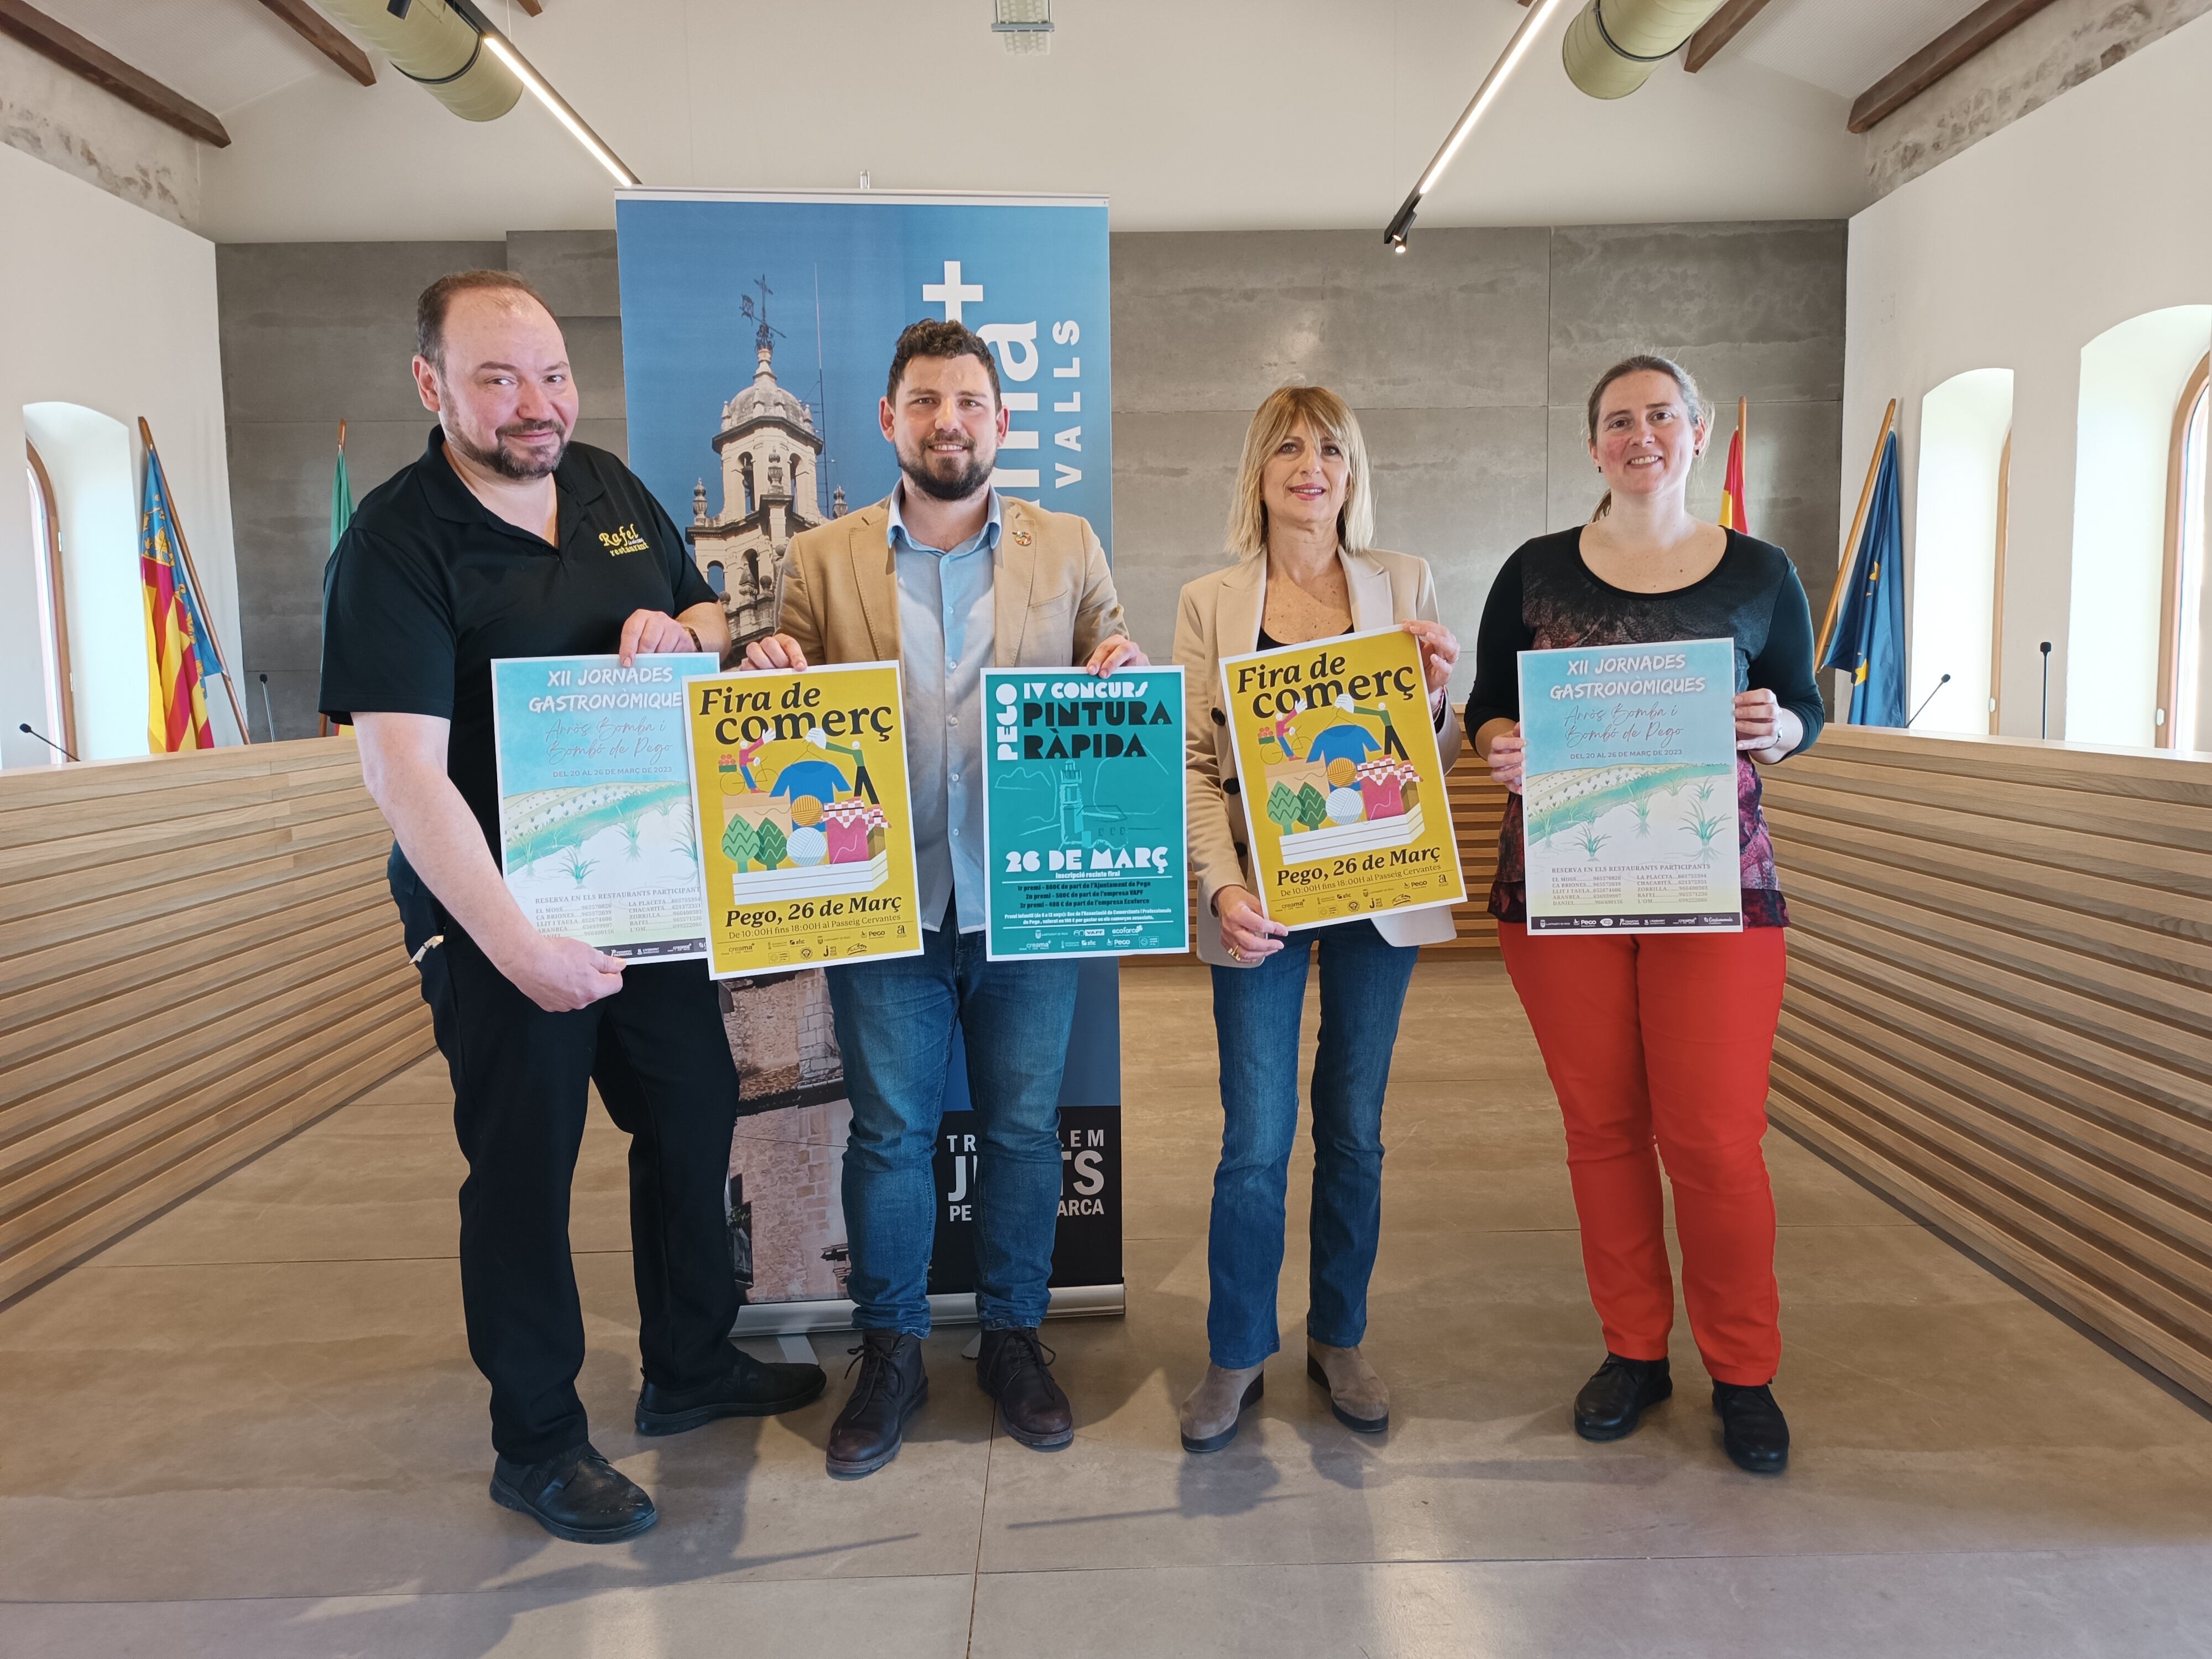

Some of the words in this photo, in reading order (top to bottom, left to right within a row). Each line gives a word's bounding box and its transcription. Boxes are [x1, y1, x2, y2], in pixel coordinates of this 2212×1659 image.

[1052, 320, 1082, 489] VALLS
[599, 524, 638, 546] Rafel
[610, 542, 649, 557] restaurant
[547, 670, 570, 687] XII
[578, 667, 673, 686] JORNADES
[1237, 664, 1302, 694] Fira
[1310, 652, 1345, 680] de
[1567, 660, 1588, 676] XII
[1595, 654, 1686, 675] JORNADES
[529, 688, 682, 713] GASTRONÒMIQUE
[700, 687, 771, 716] Fira
[781, 682, 820, 711] de
[1024, 683, 1046, 699] IV
[1051, 681, 1148, 698] CONCURS
[1253, 666, 1416, 718] comerç
[1550, 676, 1705, 700] GASTRONÒMIQUES
[715, 706, 893, 745] comerç
[996, 684, 1018, 760] PEGO
[1024, 700, 1172, 727] PINTURA
[1024, 728, 1147, 759] RÀPIDA
[1623, 726, 1641, 743] de
[1646, 722, 1684, 748] Pego
[609, 740, 629, 758] de
[634, 738, 673, 765] Pego
[1005, 851, 1040, 872] 26
[1049, 849, 1082, 870] DE
[1090, 846, 1168, 874] MARÇ
[1277, 868, 1328, 886] Pego,
[1333, 858, 1357, 876] 26
[1363, 854, 1385, 870] de
[1390, 846, 1440, 866] Març
[1292, 884, 1321, 894] 10:00H
[1337, 877, 1365, 887] 18:00H
[1375, 870, 1402, 881] Passeig
[1404, 864, 1441, 875] Cervantes
[726, 910, 782, 927] Pego,
[788, 902, 814, 920] 26
[820, 900, 843, 915] de
[848, 896, 902, 914] Març
[742, 928, 773, 938] 10:00H
[792, 923, 821, 932] 18:00H
[832, 918, 860, 928] Passeig
[862, 914, 901, 925] Cervantes
